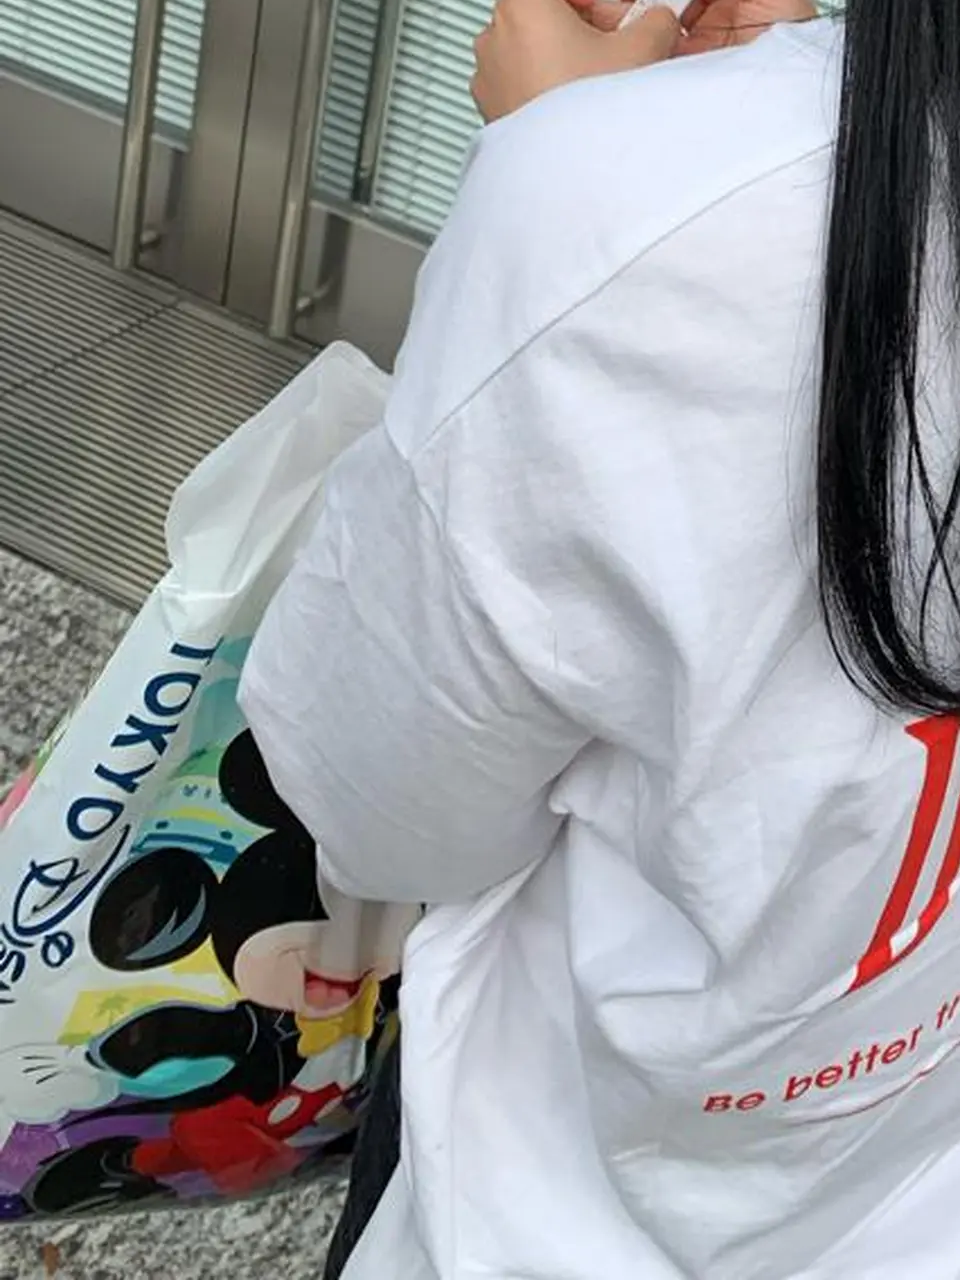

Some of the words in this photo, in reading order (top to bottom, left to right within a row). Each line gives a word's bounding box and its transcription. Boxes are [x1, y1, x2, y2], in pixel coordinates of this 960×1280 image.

[66, 636, 224, 841] TOKYO
[703, 1091, 765, 1113] Be
[782, 1023, 923, 1103] better
